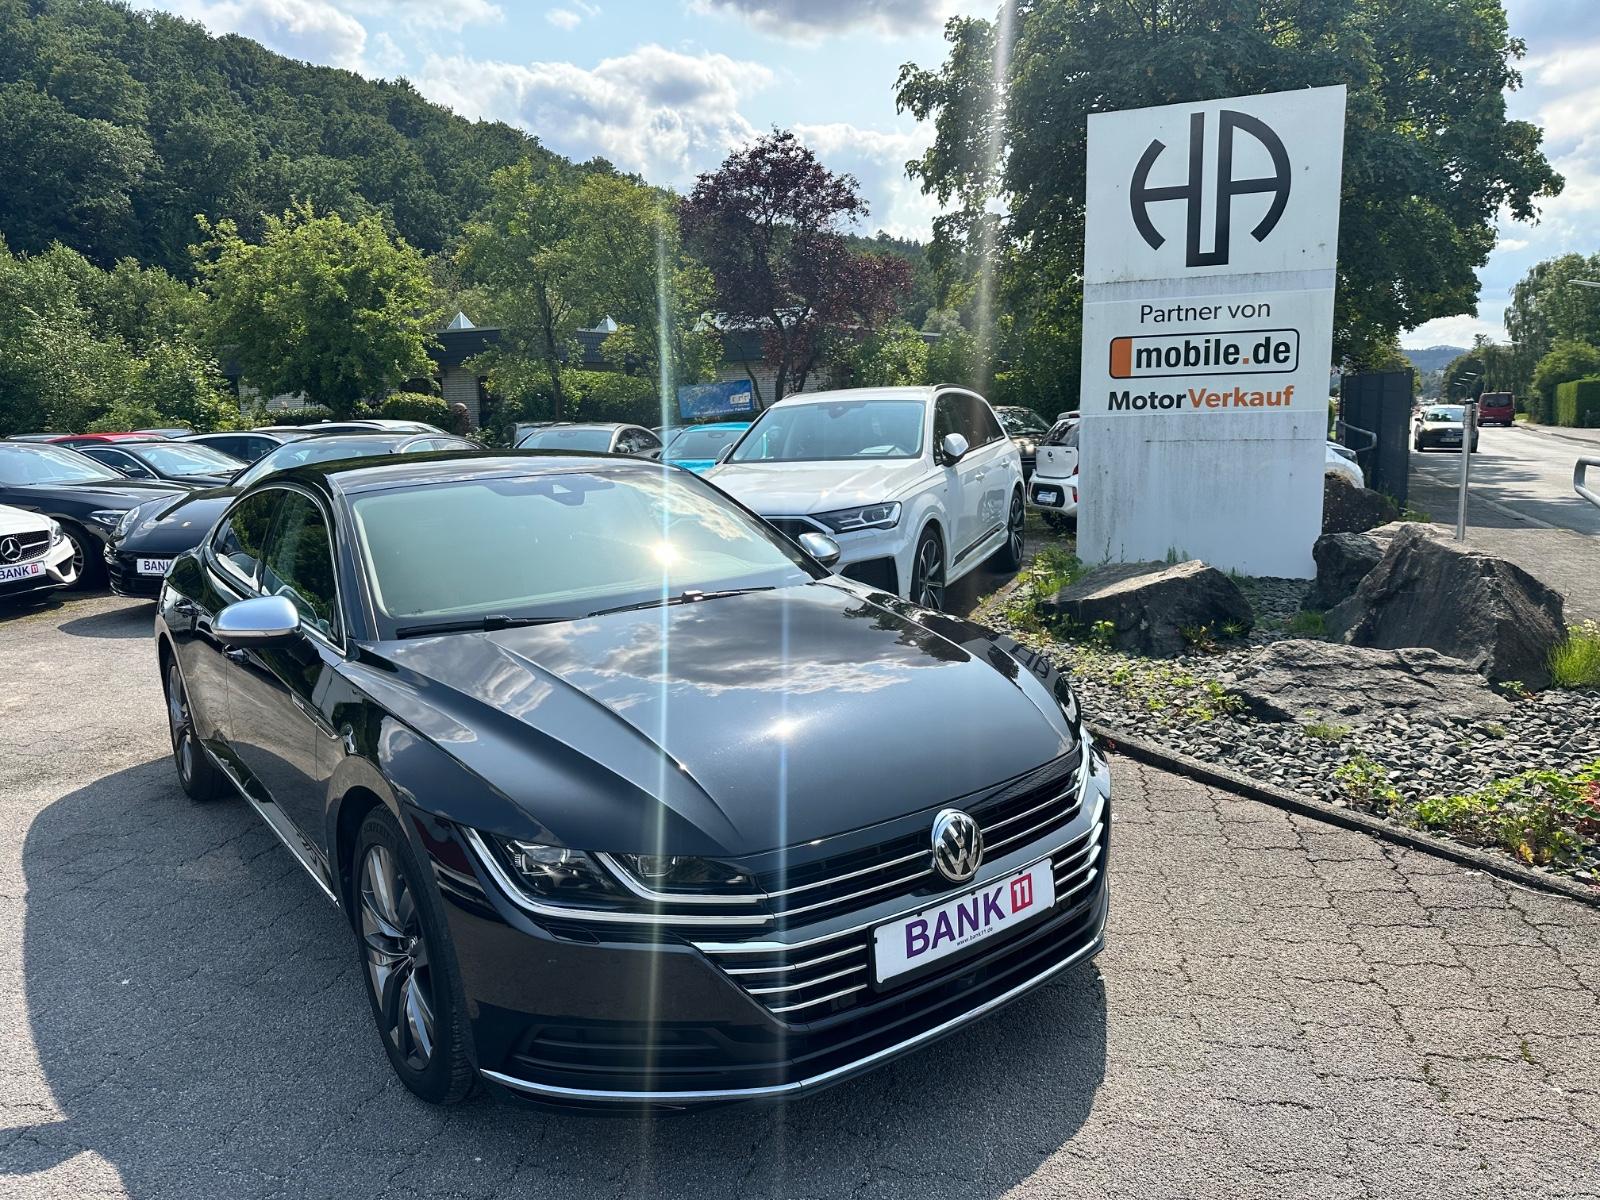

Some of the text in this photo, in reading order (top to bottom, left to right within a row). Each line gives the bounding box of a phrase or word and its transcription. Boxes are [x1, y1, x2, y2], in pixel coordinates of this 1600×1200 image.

[1139, 301, 1271, 323] Partner von
[1135, 337, 1291, 368] mobile.de
[1107, 385, 1295, 411] MotorVerkauf
[0, 565, 30, 580] BANK
[905, 876, 1031, 959] BANK 11
